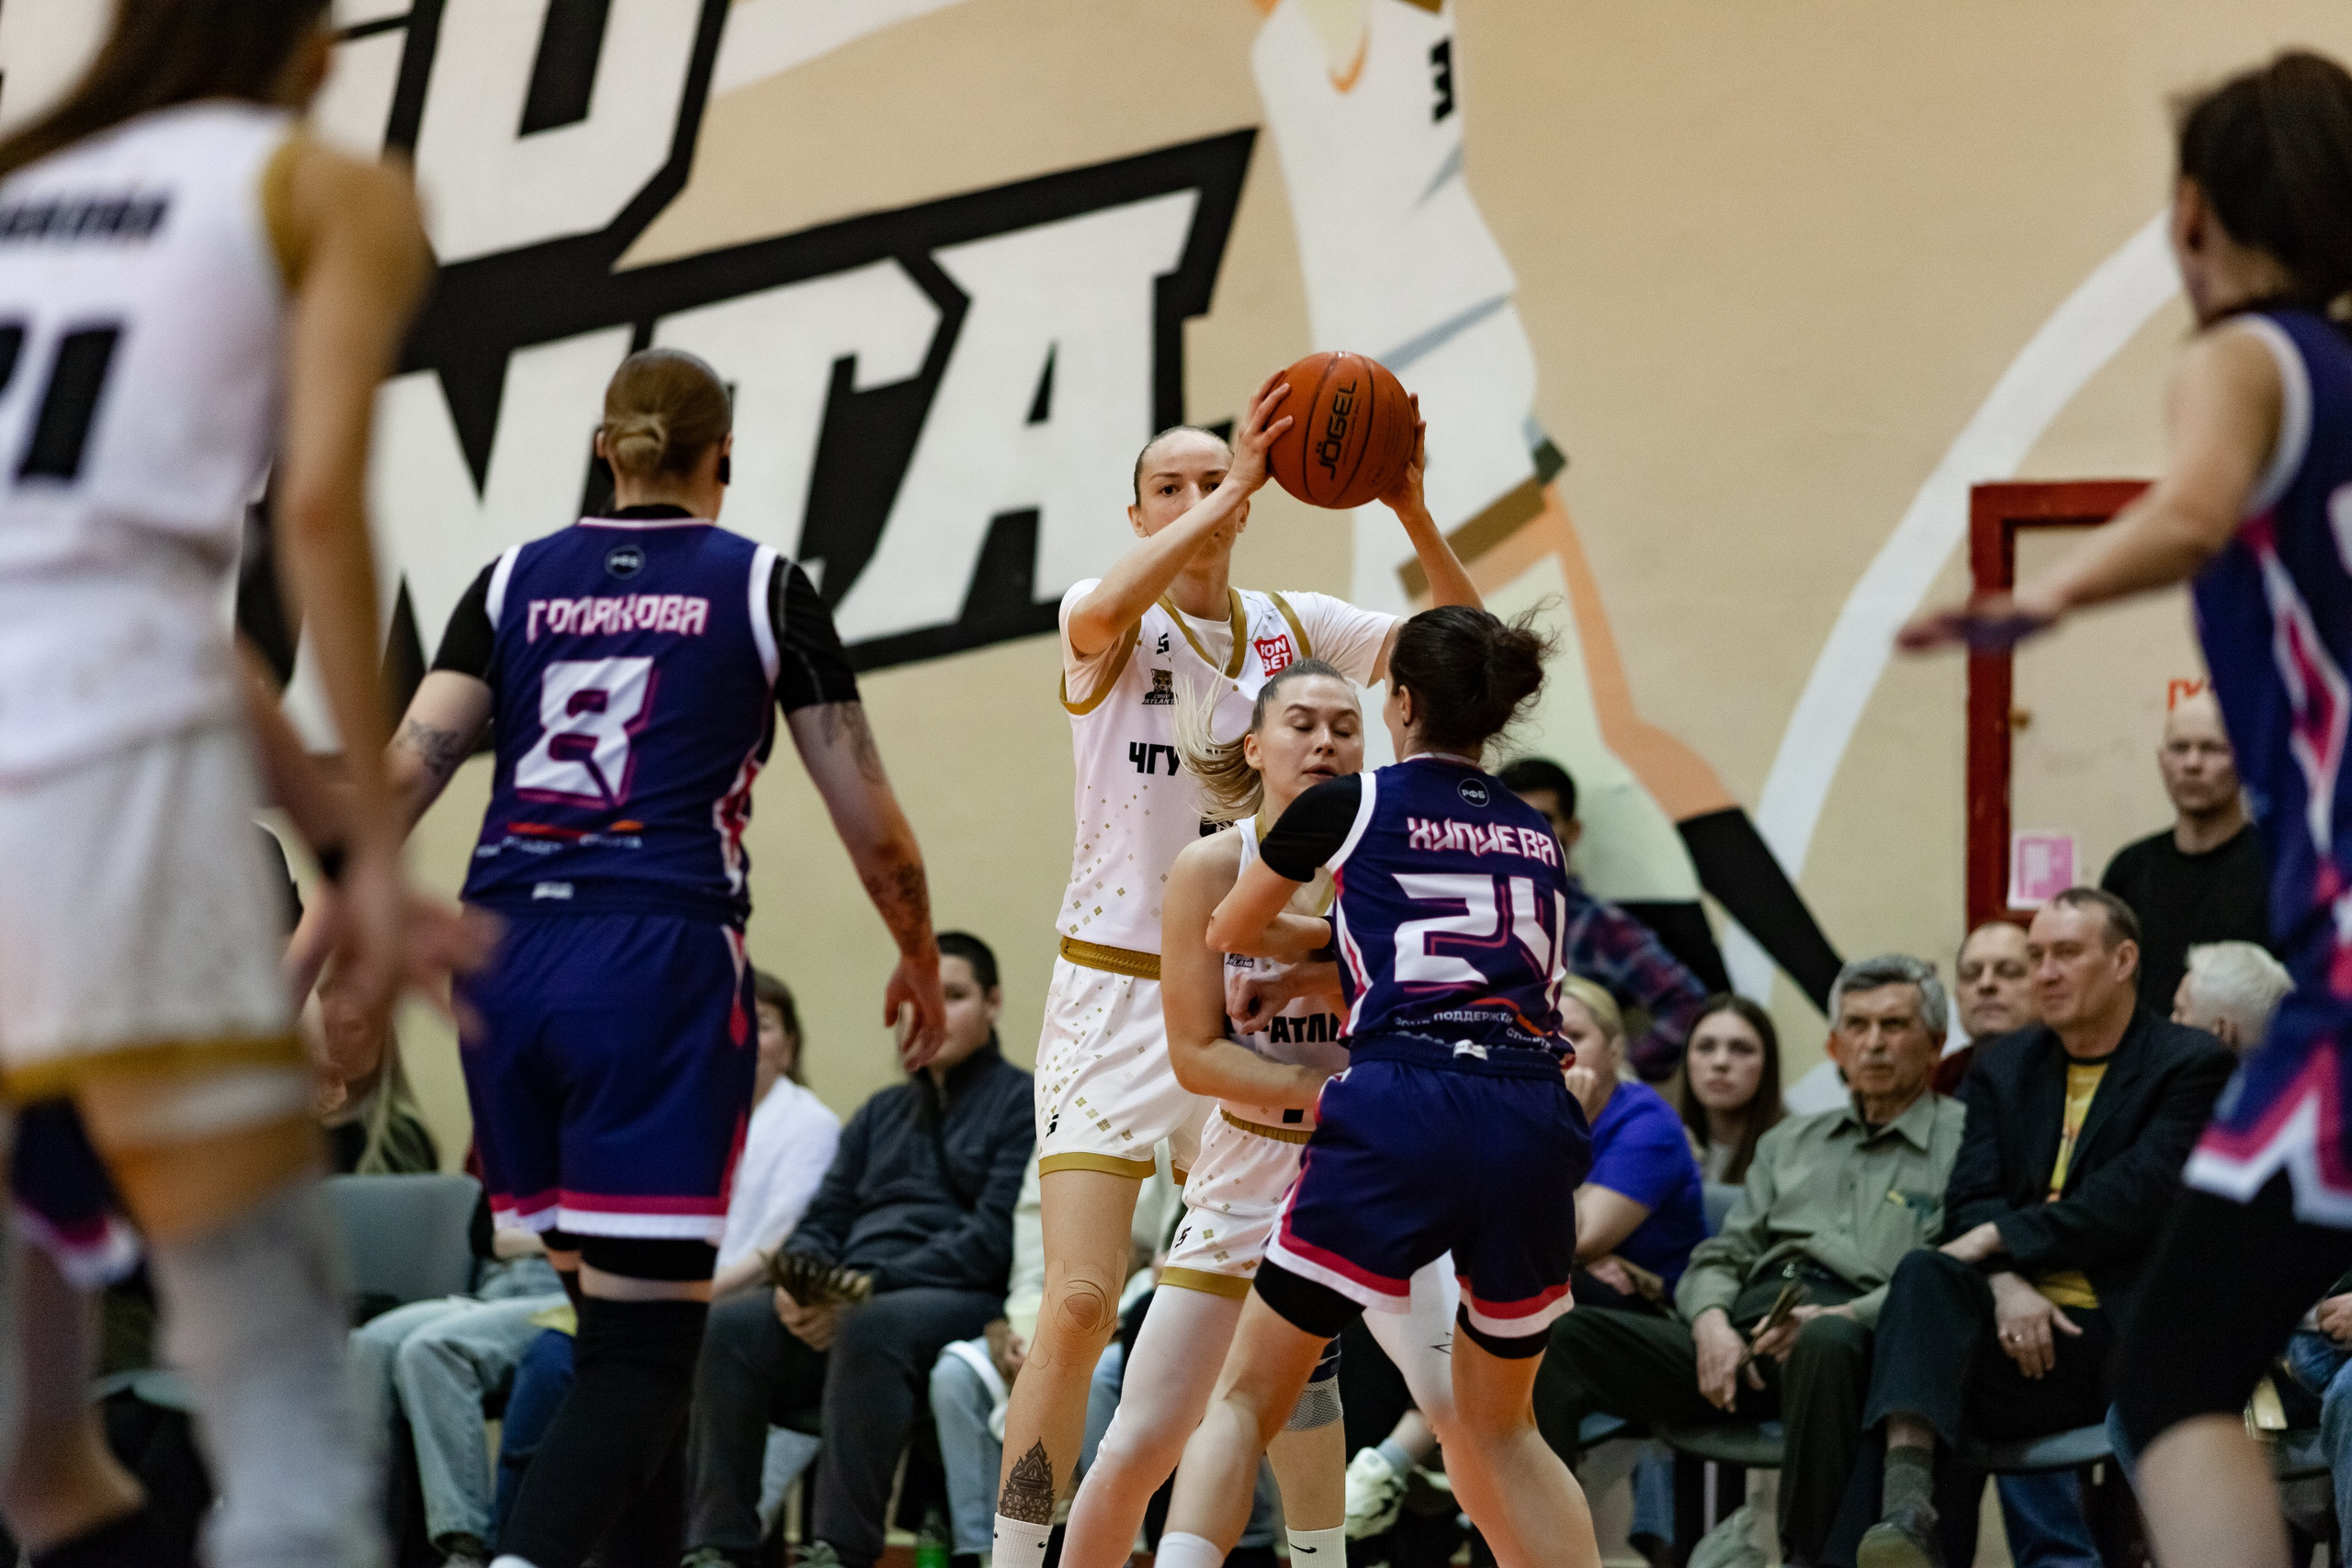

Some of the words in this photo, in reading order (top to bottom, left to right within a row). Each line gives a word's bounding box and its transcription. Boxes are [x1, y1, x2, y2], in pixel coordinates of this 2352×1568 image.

[1316, 379, 1357, 480] JÖGEL
[1262, 651, 1291, 672] BET
[514, 656, 659, 809] 8
[1391, 873, 1566, 1009] 24
